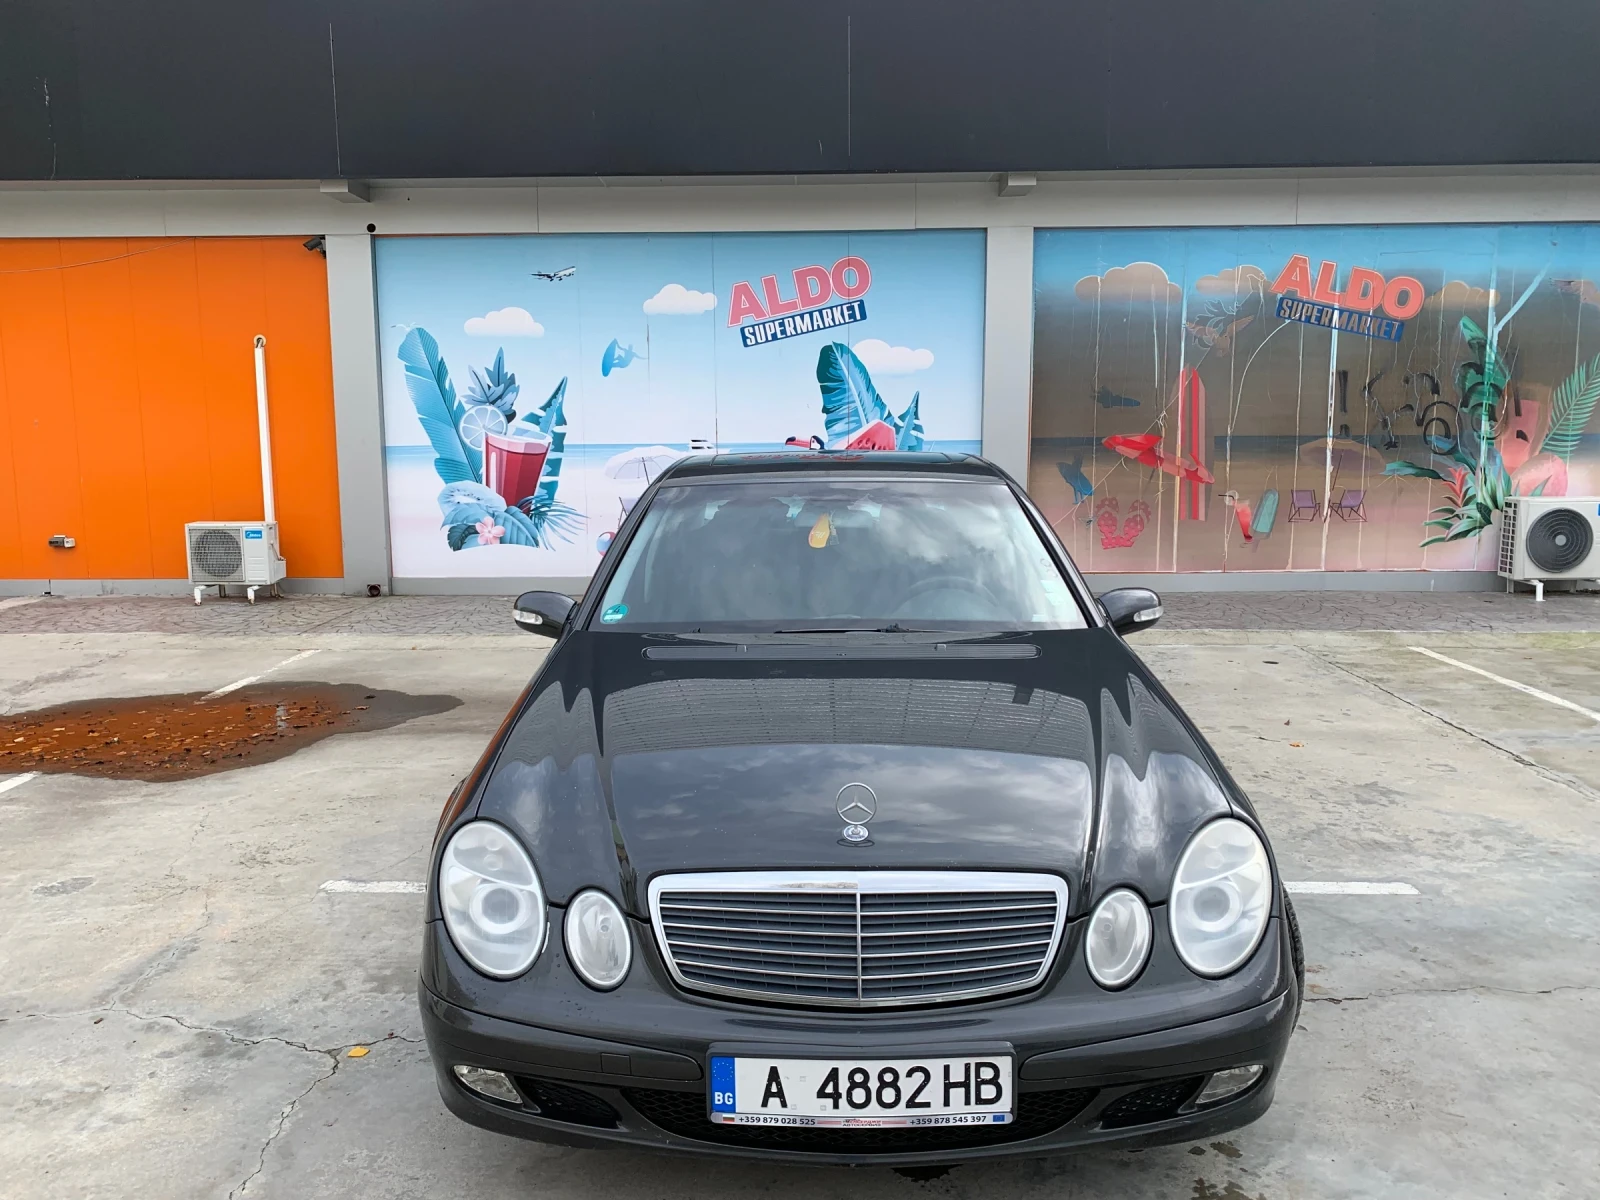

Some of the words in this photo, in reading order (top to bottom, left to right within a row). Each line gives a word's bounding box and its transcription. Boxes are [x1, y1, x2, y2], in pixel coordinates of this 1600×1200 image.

[727, 256, 872, 328] ALDO
[1269, 254, 1425, 320] ALDO
[743, 301, 862, 346] SUPERMARKET
[1279, 298, 1400, 341] SUPERMARKET
[714, 1091, 734, 1105] BG
[760, 1065, 788, 1108] A
[816, 1066, 931, 1110] 4882
[942, 1061, 1003, 1108] HB
[762, 1116, 779, 1124] 879
[780, 1117, 797, 1125] 028
[799, 1118, 816, 1126] 525
